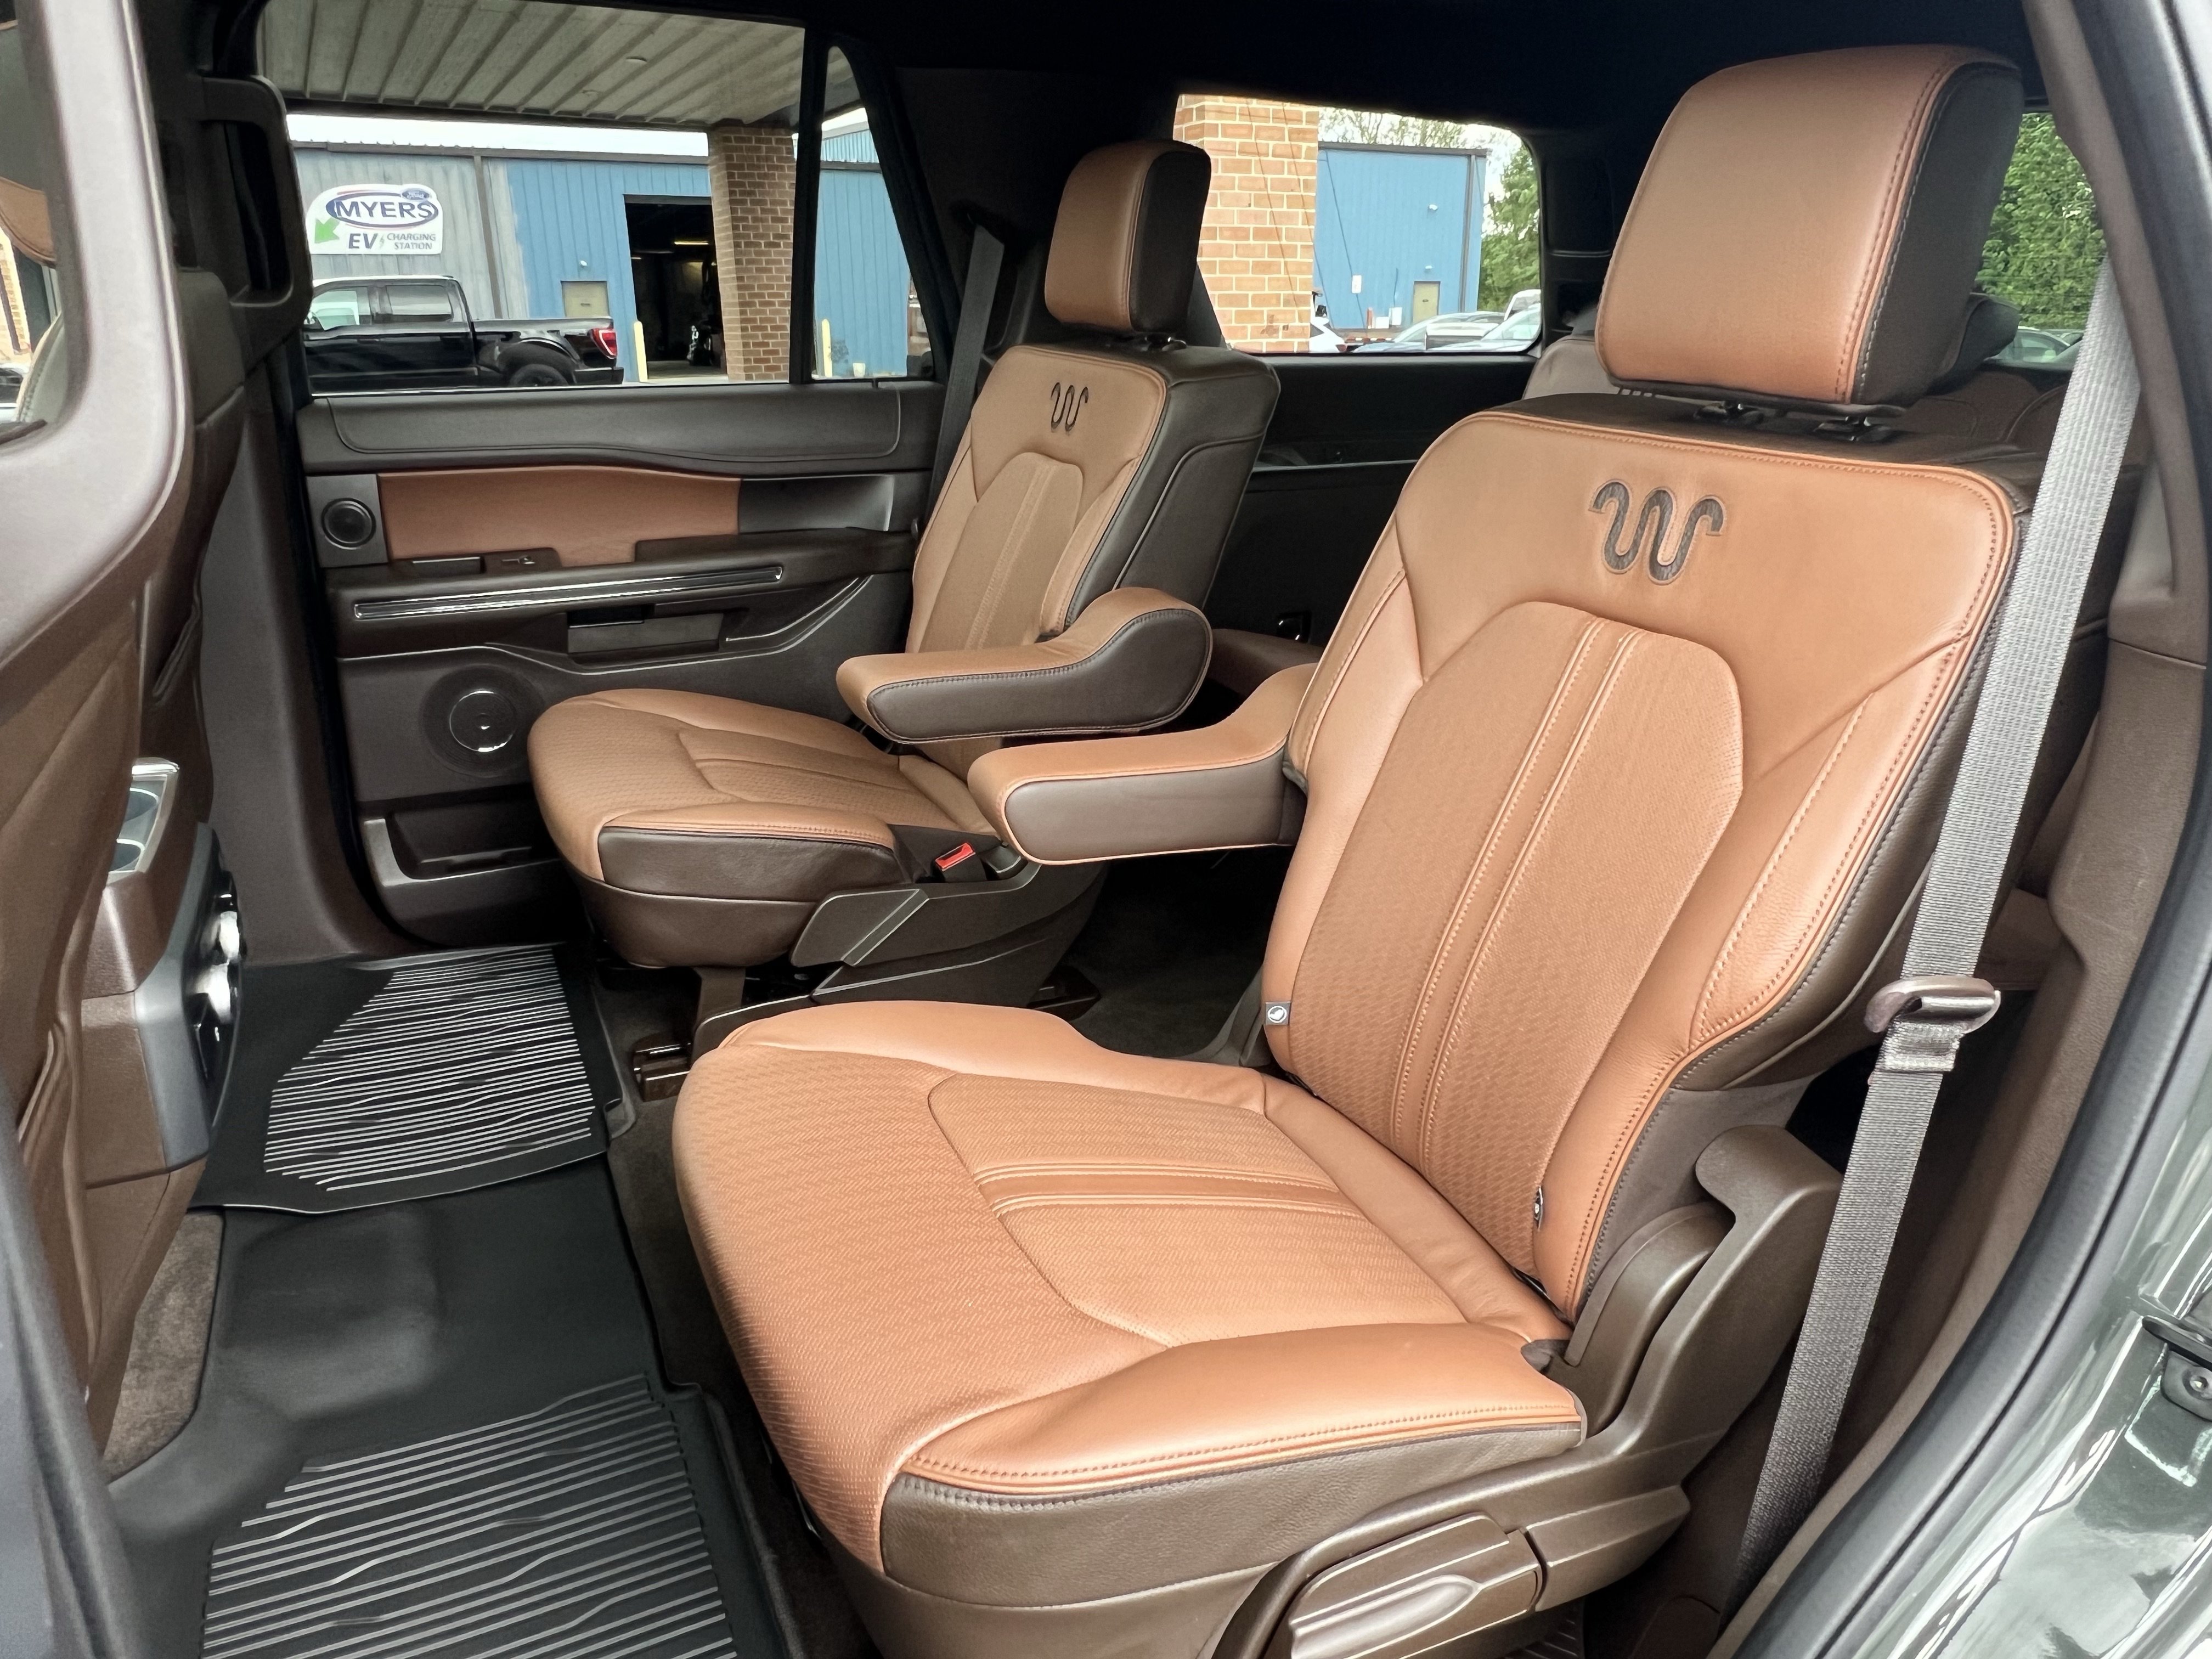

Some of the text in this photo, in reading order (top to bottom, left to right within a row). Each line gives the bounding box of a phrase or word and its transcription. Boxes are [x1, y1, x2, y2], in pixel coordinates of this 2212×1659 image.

[336, 201, 432, 218] MYERS
[348, 233, 436, 249] EV CHARGING
